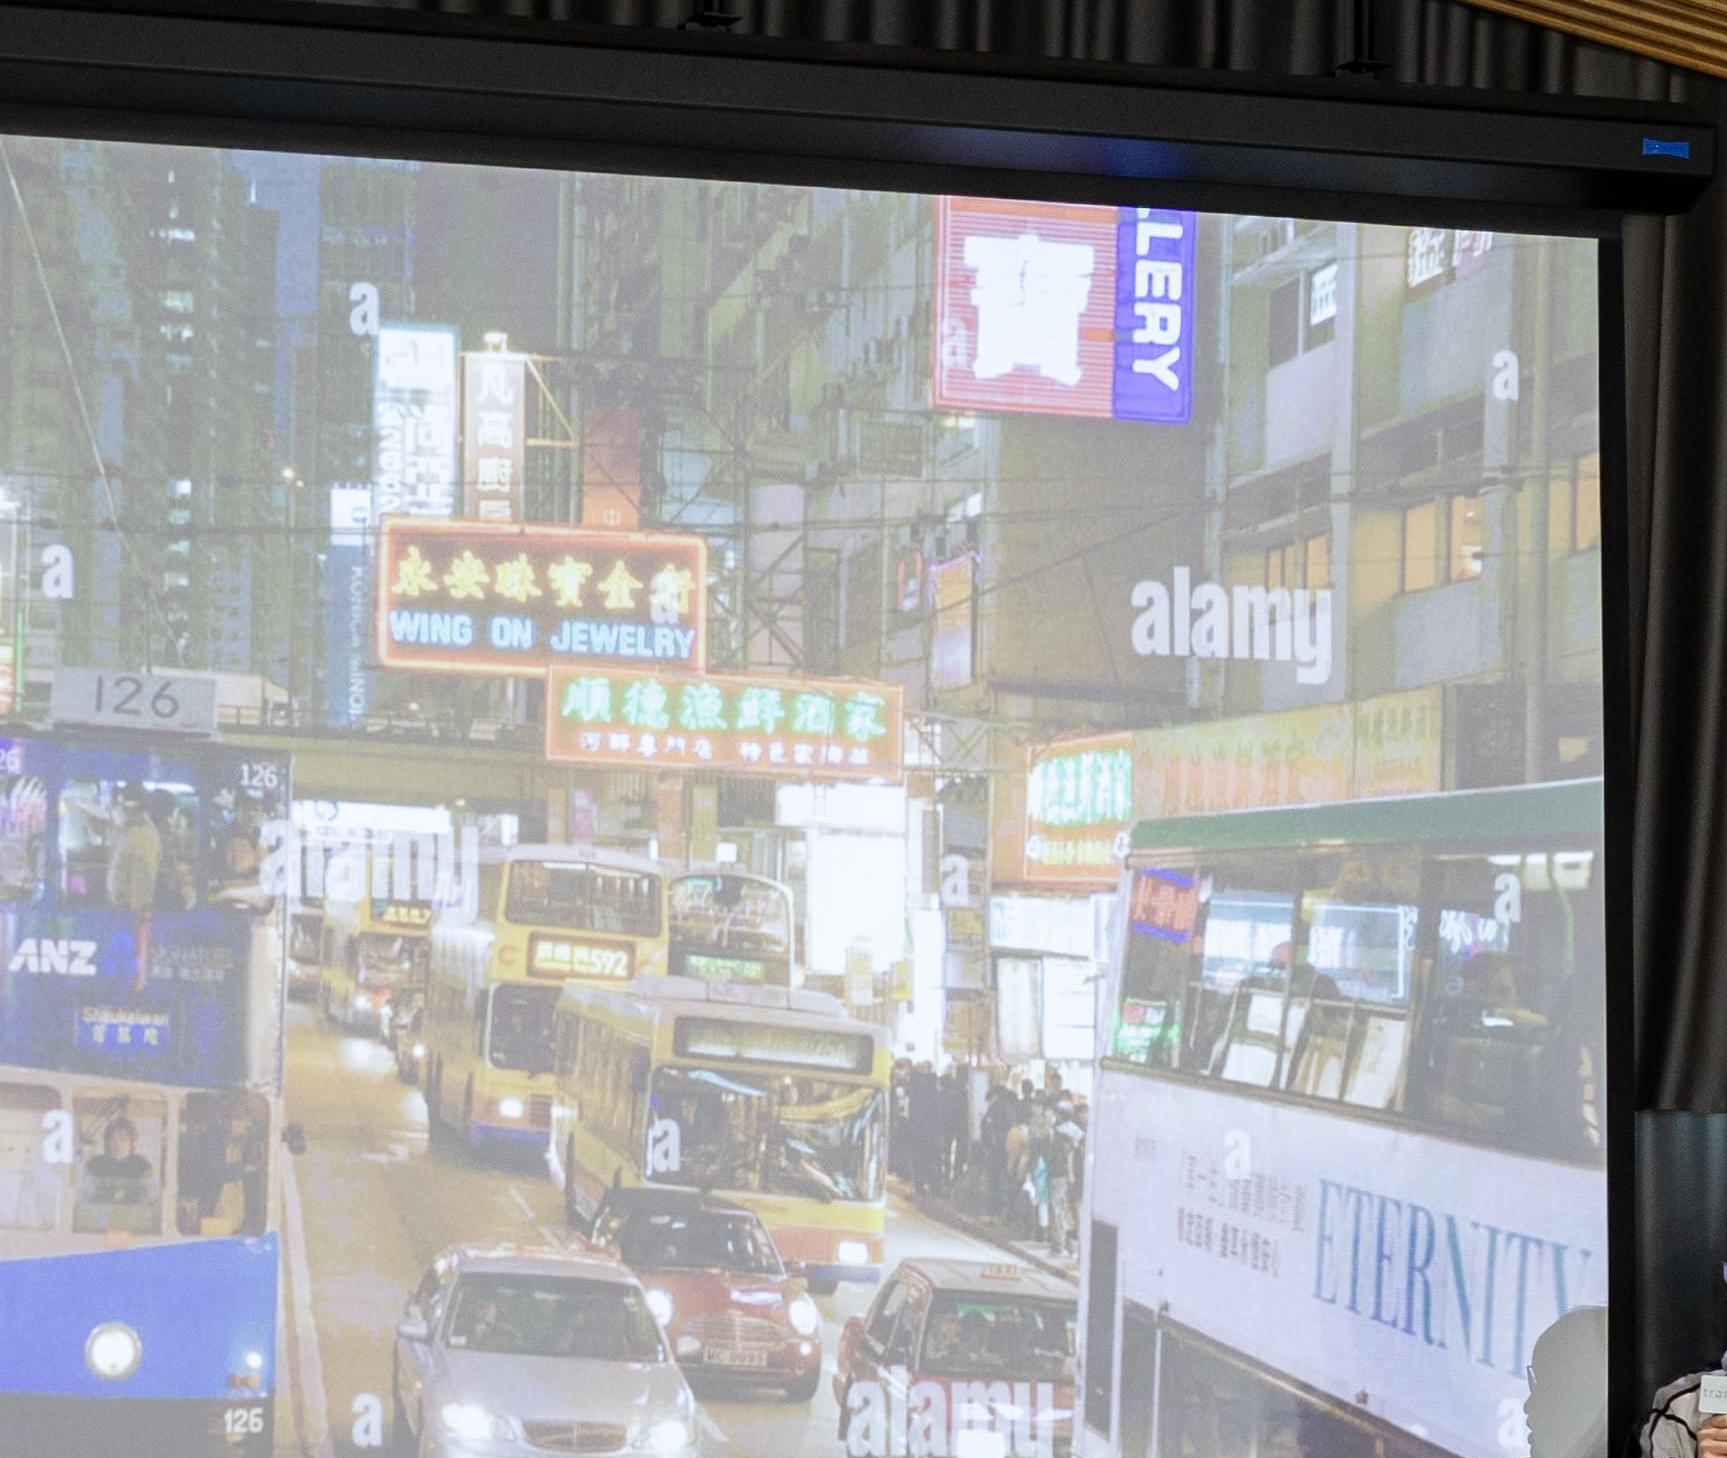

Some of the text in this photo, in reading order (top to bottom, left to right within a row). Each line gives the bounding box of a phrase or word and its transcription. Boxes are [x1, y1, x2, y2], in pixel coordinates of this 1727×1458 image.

[1133, 207, 1183, 391] LERY
[389, 610, 696, 660] WING ON JEWELRY
[1131, 565, 1333, 685] alamy
[94, 674, 180, 720] 126
[238, 763, 278, 788] 126
[9, 938, 98, 976] ANZ
[223, 1406, 264, 1434] 126
